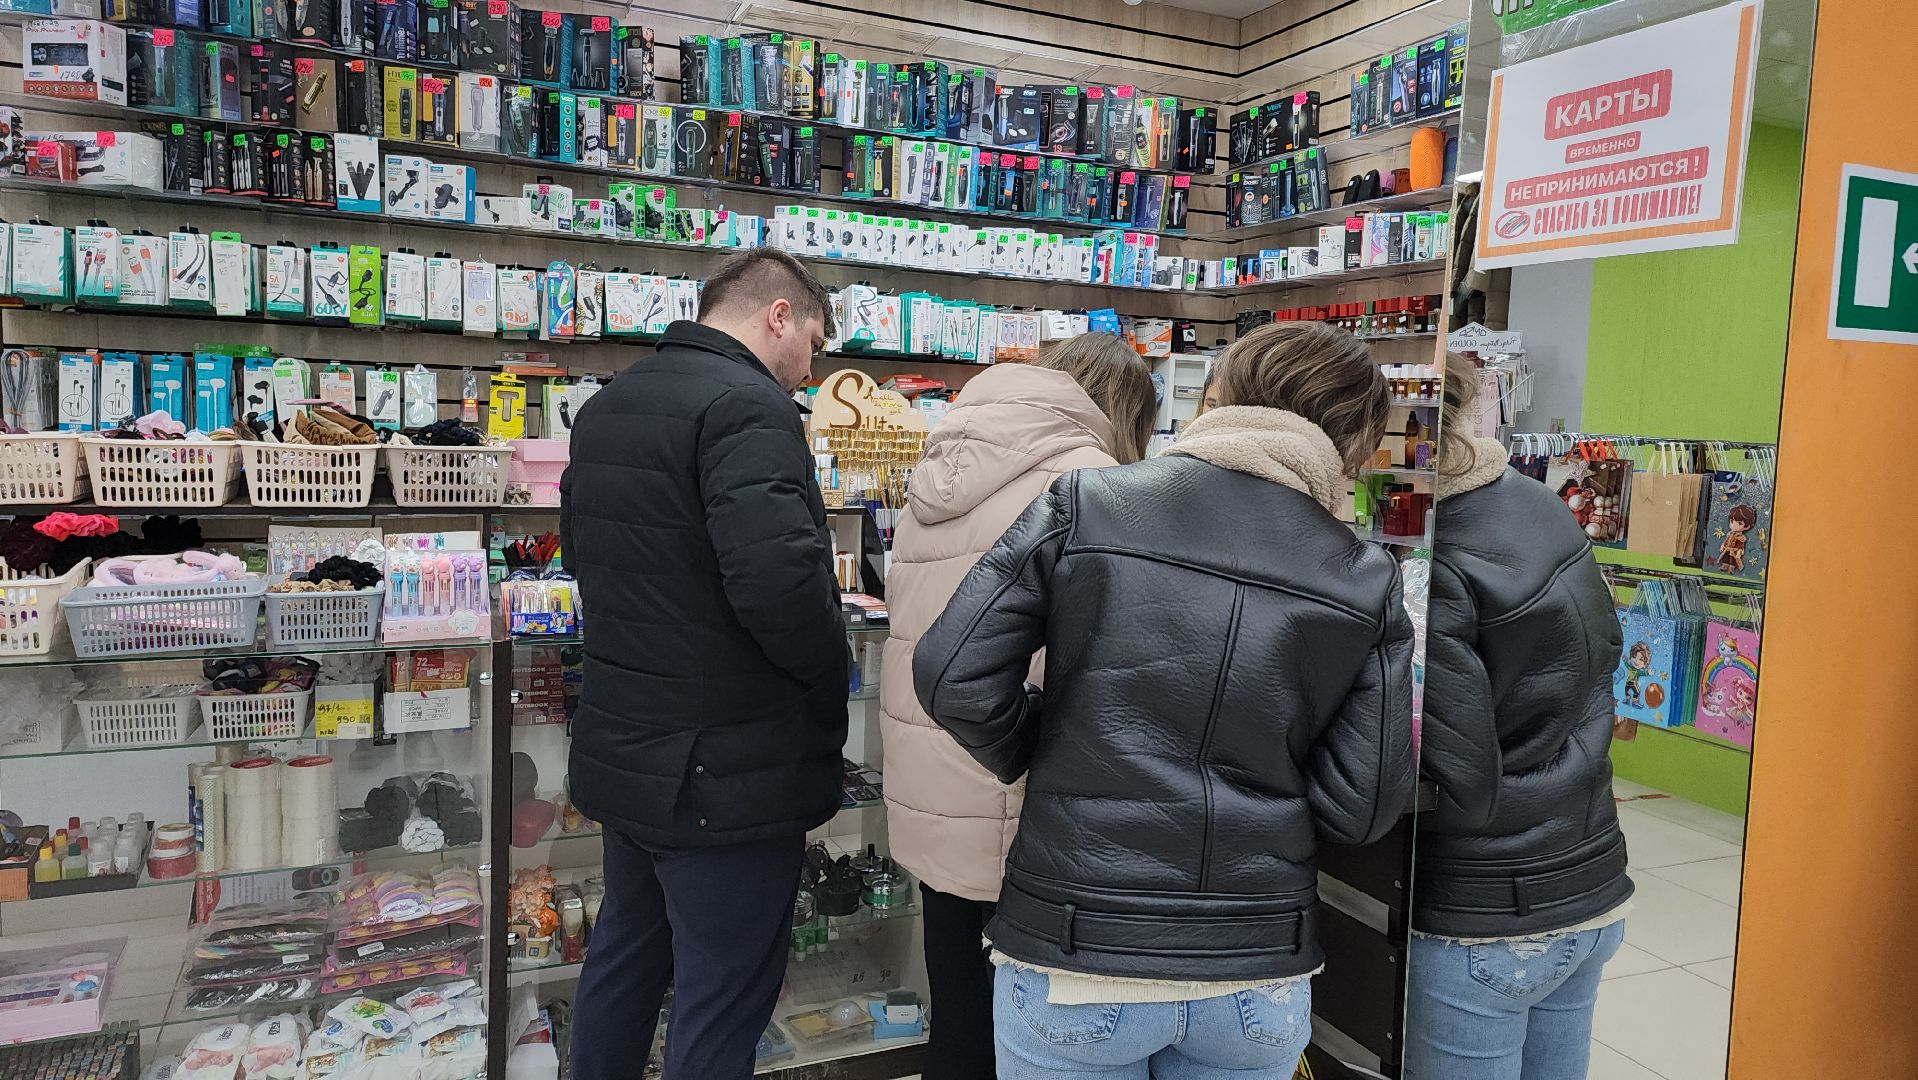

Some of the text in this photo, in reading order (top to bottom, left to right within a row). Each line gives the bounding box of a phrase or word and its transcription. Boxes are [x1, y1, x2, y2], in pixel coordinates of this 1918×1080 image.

[1554, 82, 1660, 130] КАРТЫ
[1569, 137, 1636, 159] ВРЕМЕННО
[1533, 184, 1702, 235] СПАСИБО ЗА ПОНИМАНИЕ!
[416, 657, 428, 667] 72
